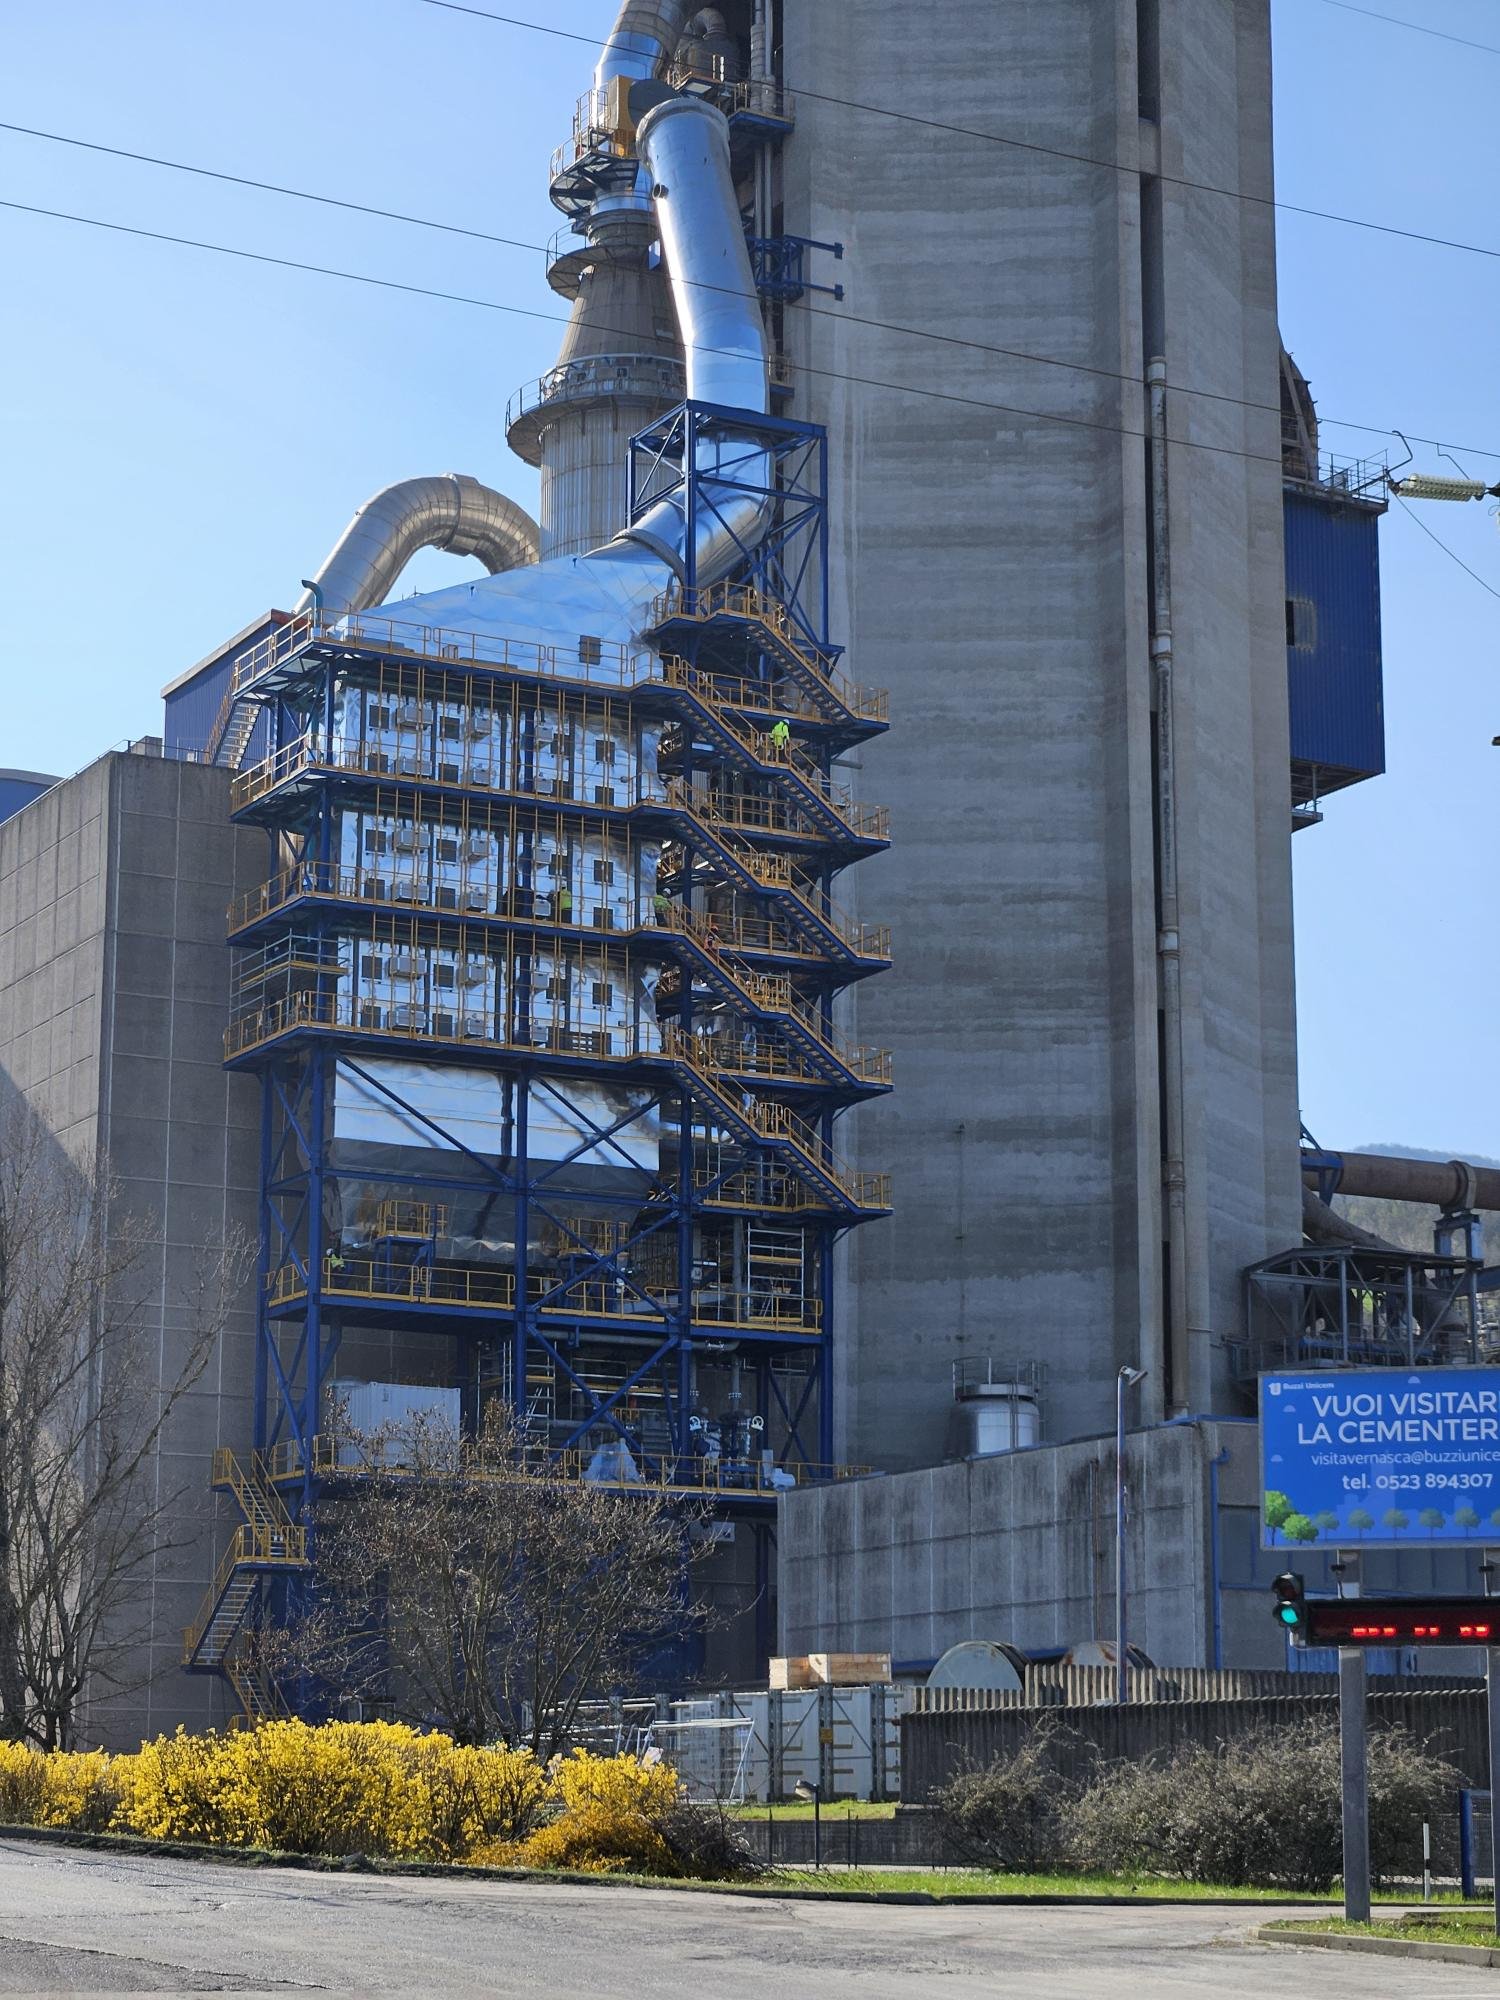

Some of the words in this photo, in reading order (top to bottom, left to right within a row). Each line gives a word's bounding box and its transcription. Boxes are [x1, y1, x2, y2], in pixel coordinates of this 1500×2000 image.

[1312, 1394, 1382, 1417] VUOI
[1389, 1391, 1500, 1415] VISITAR
[1298, 1422, 1332, 1444] LA
[1342, 1472, 1371, 1490] tel.
[1375, 1474, 1420, 1490] 0523
[1425, 1472, 1493, 1489] 894307
